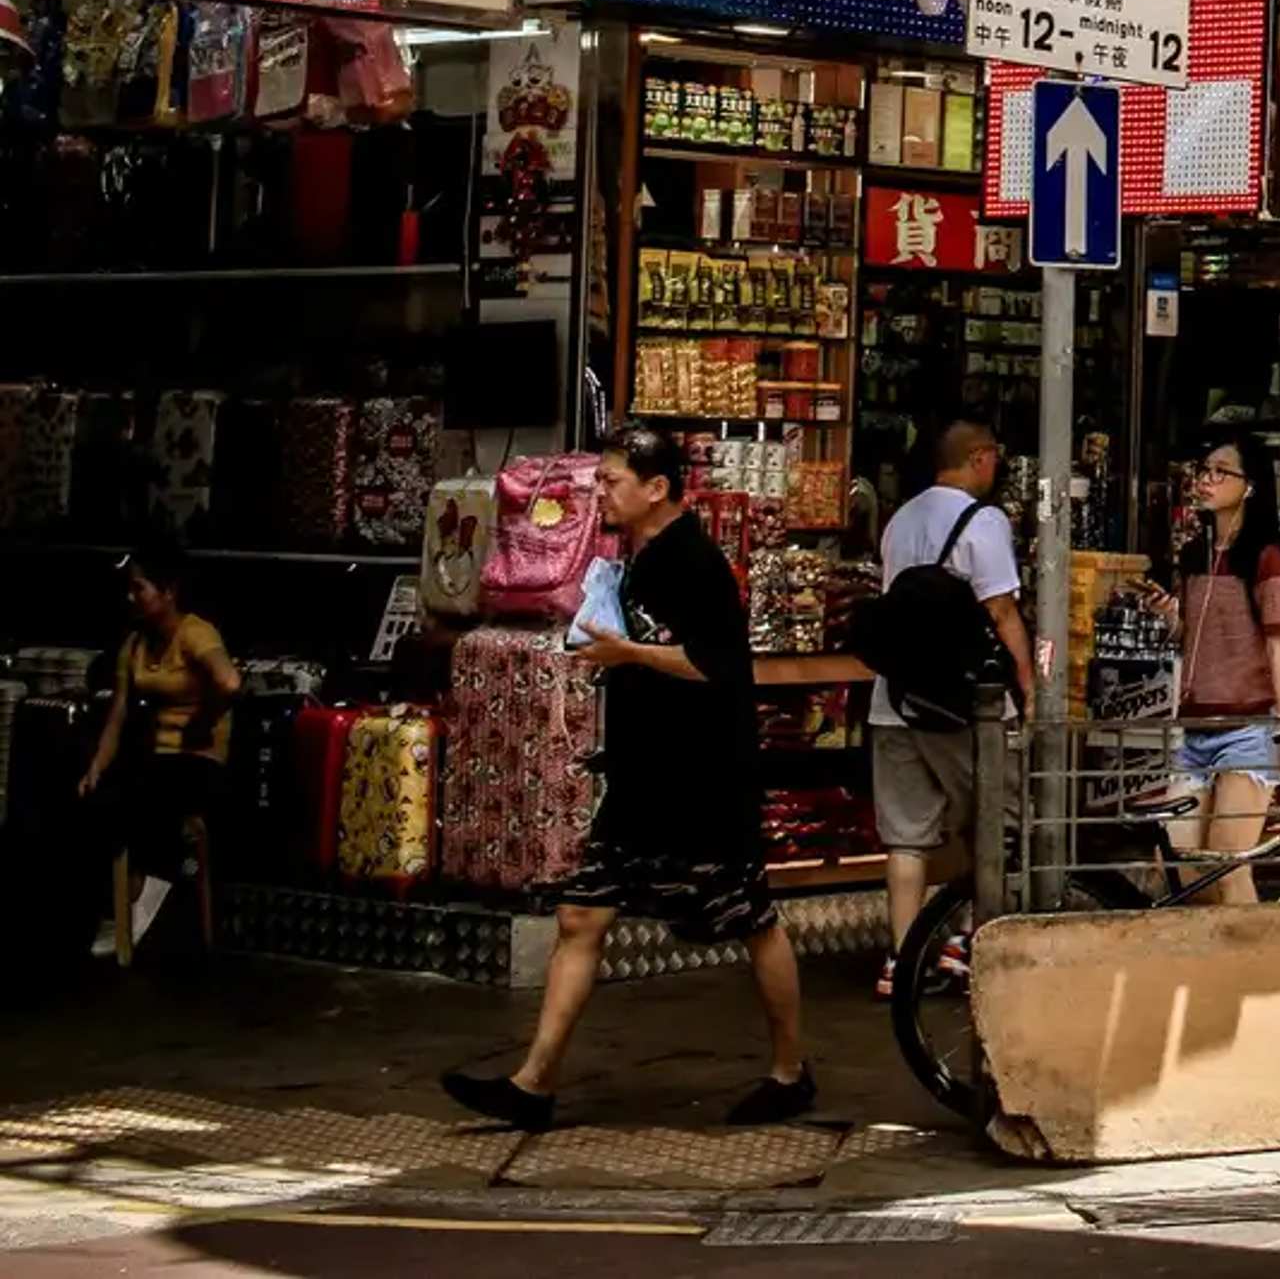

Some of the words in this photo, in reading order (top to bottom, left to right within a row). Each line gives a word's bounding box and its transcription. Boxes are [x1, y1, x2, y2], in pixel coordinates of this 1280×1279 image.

[1079, 14, 1144, 39] midnight
[974, 22, 1012, 50] 中午
[1093, 42, 1129, 69] 午夜
[1149, 29, 1183, 73] 12
